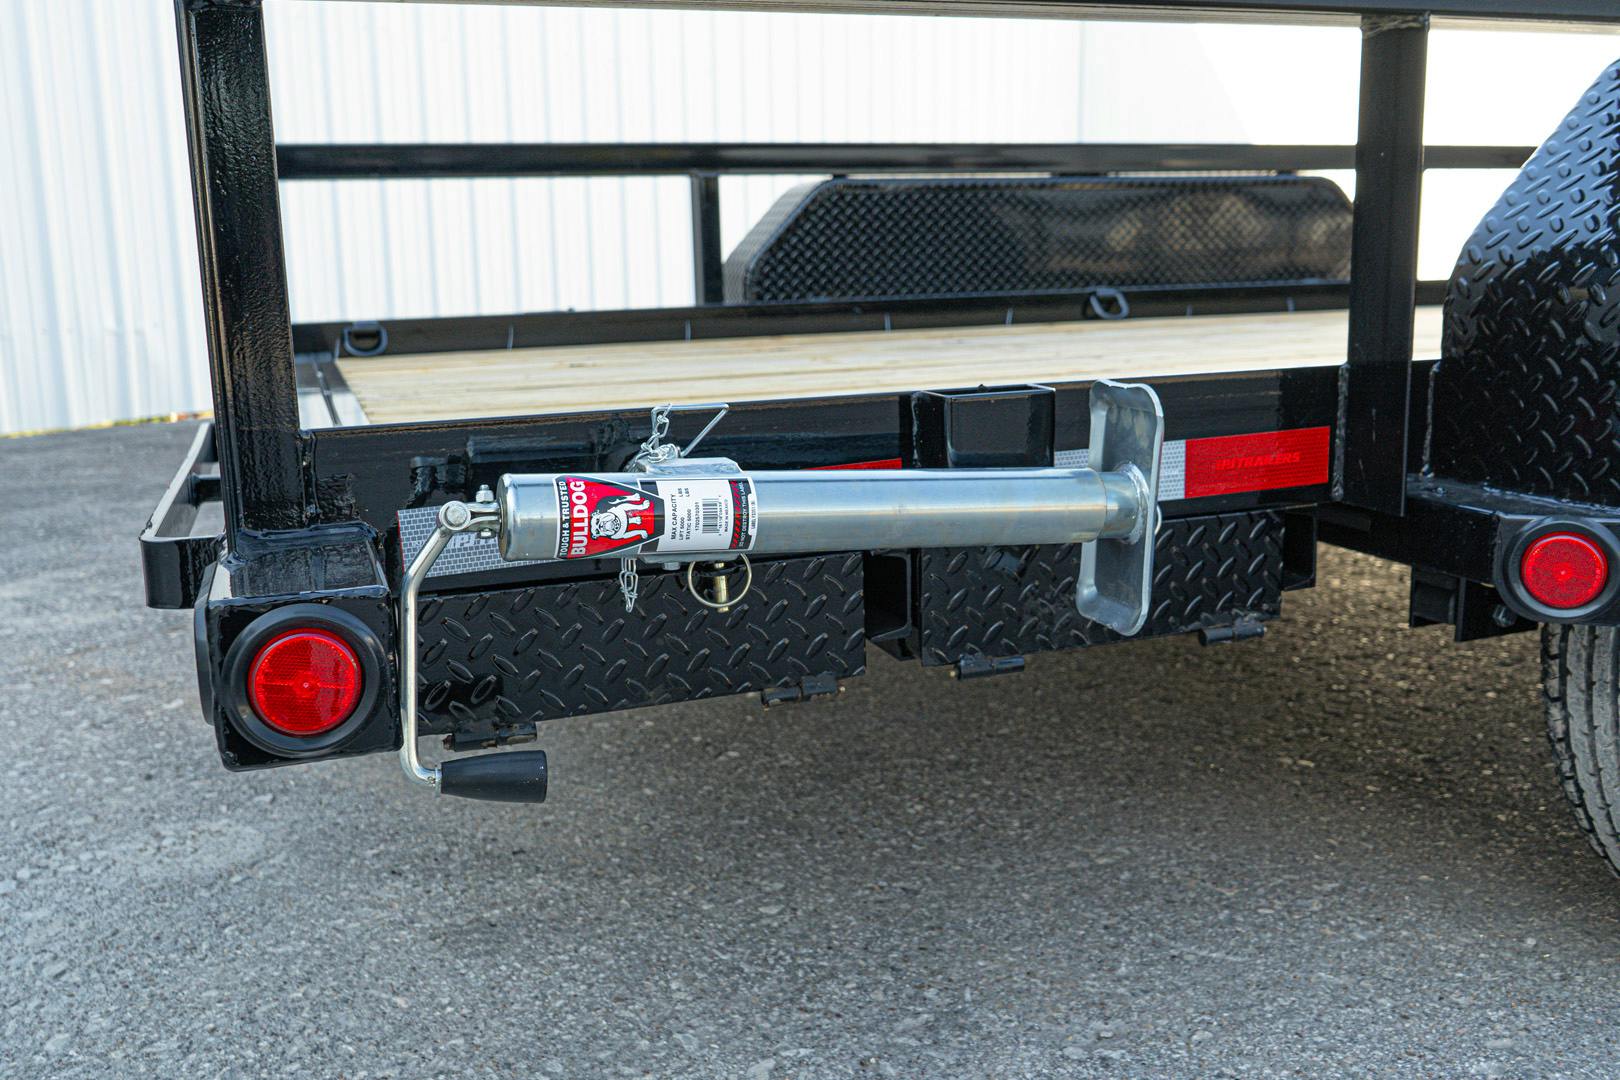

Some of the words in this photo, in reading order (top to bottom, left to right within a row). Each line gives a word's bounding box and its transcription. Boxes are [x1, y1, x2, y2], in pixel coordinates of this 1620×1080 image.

[559, 481, 569, 520] TRUSTED
[738, 482, 746, 495] LABEL
[570, 481, 588, 555] BULLDOG
[560, 529, 569, 556] TOUGH
